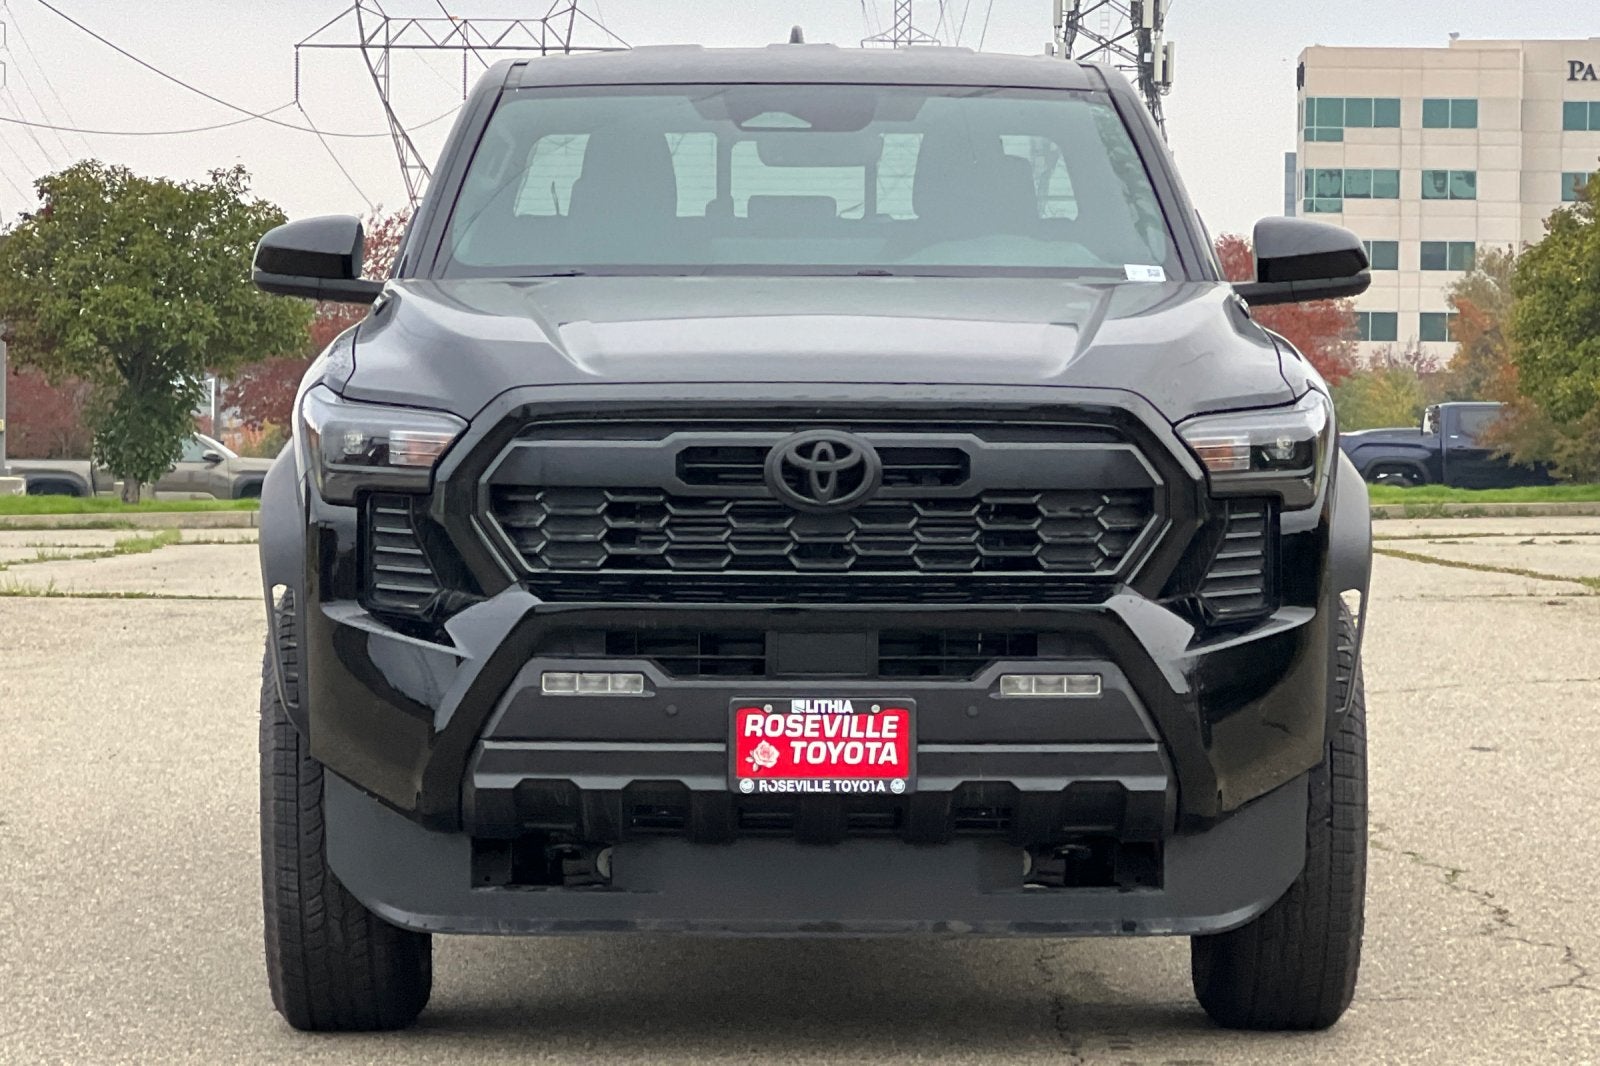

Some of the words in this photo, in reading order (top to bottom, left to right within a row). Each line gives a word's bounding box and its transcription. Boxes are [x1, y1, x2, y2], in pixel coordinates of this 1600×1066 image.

[806, 700, 854, 714] LITHIA
[744, 714, 899, 739] ROSEVILLE
[790, 740, 899, 765] TOYOTA
[759, 780, 831, 793] ROSEVILLE
[833, 780, 886, 793] TOYOTA
